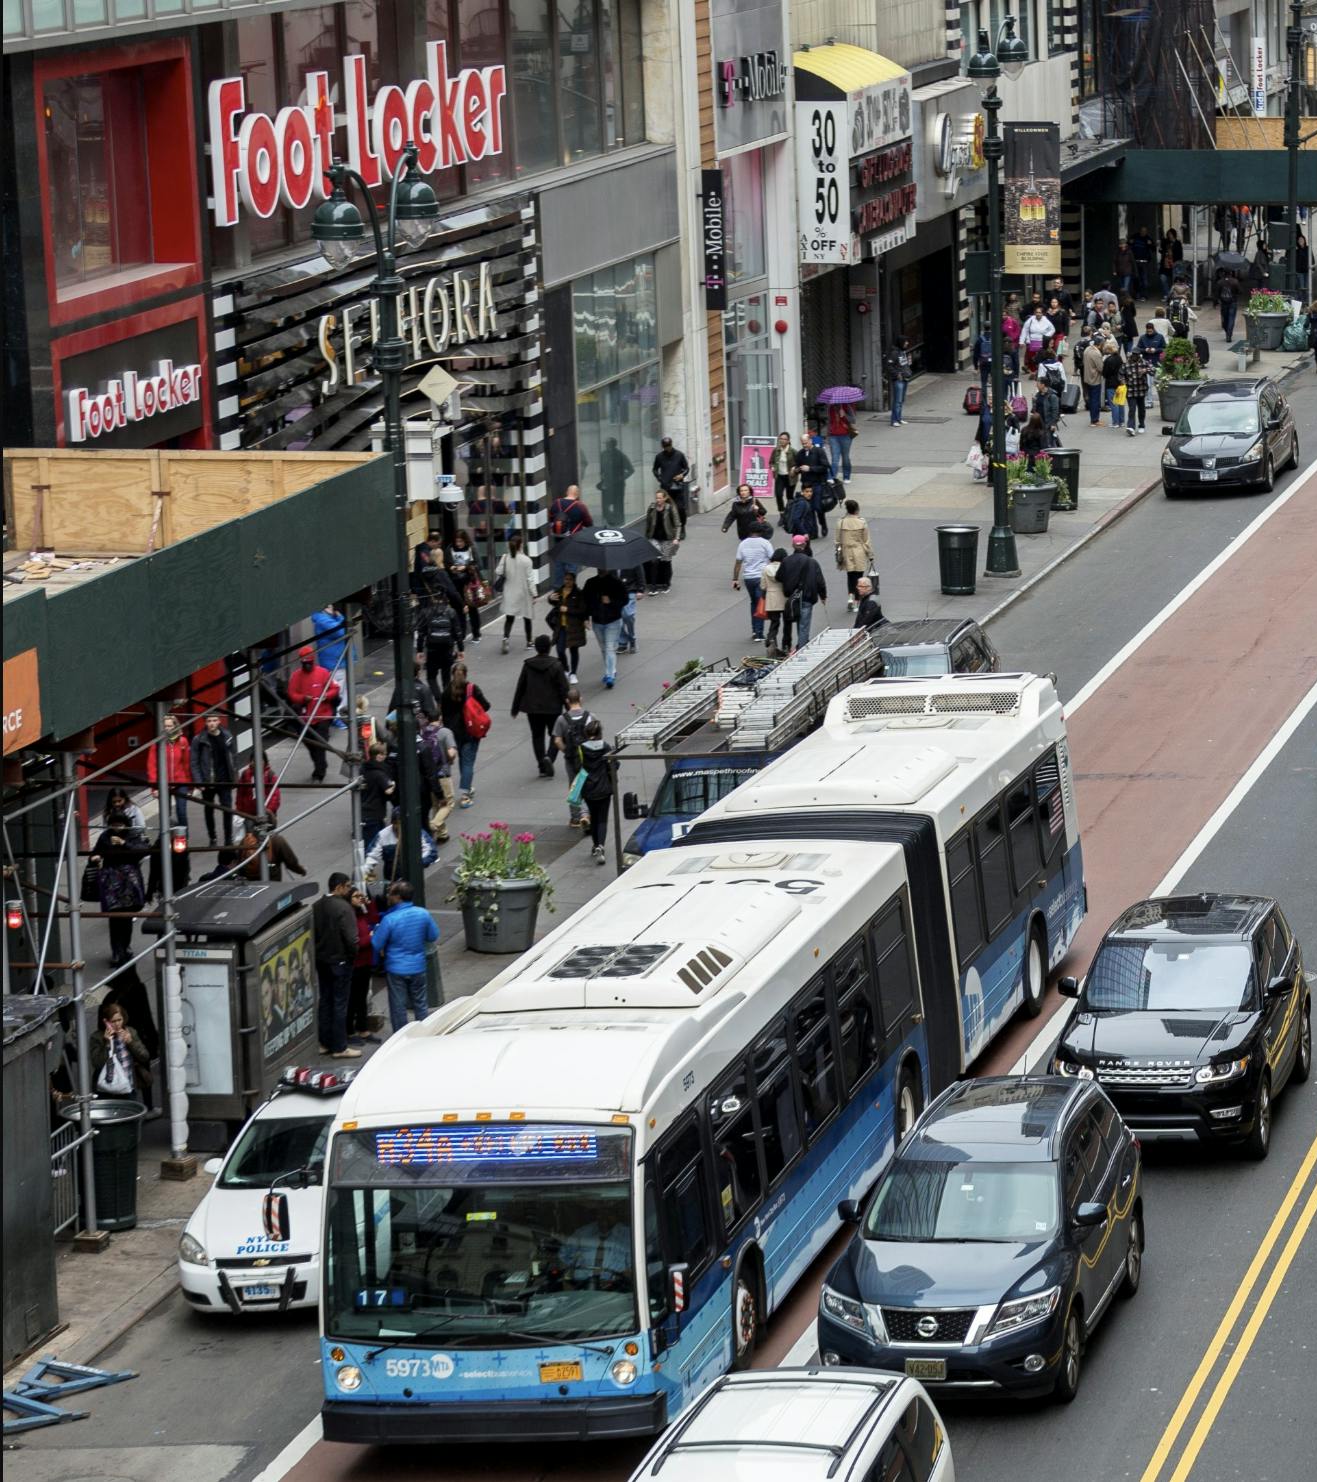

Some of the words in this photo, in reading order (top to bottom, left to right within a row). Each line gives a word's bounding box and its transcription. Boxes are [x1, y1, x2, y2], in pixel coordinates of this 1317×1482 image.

[208, 71, 335, 226] Foot
[344, 40, 506, 188] Locker
[812, 109, 836, 158] 30
[818, 160, 836, 173] to
[815, 177, 839, 224] 50
[810, 239, 837, 251] OFF
[69, 379, 128, 443] Foot
[123, 359, 202, 422] Locker
[182, 949, 208, 957] TITAN
[236, 1243, 289, 1255] POLICE
[386, 1359, 430, 1377] 5973
